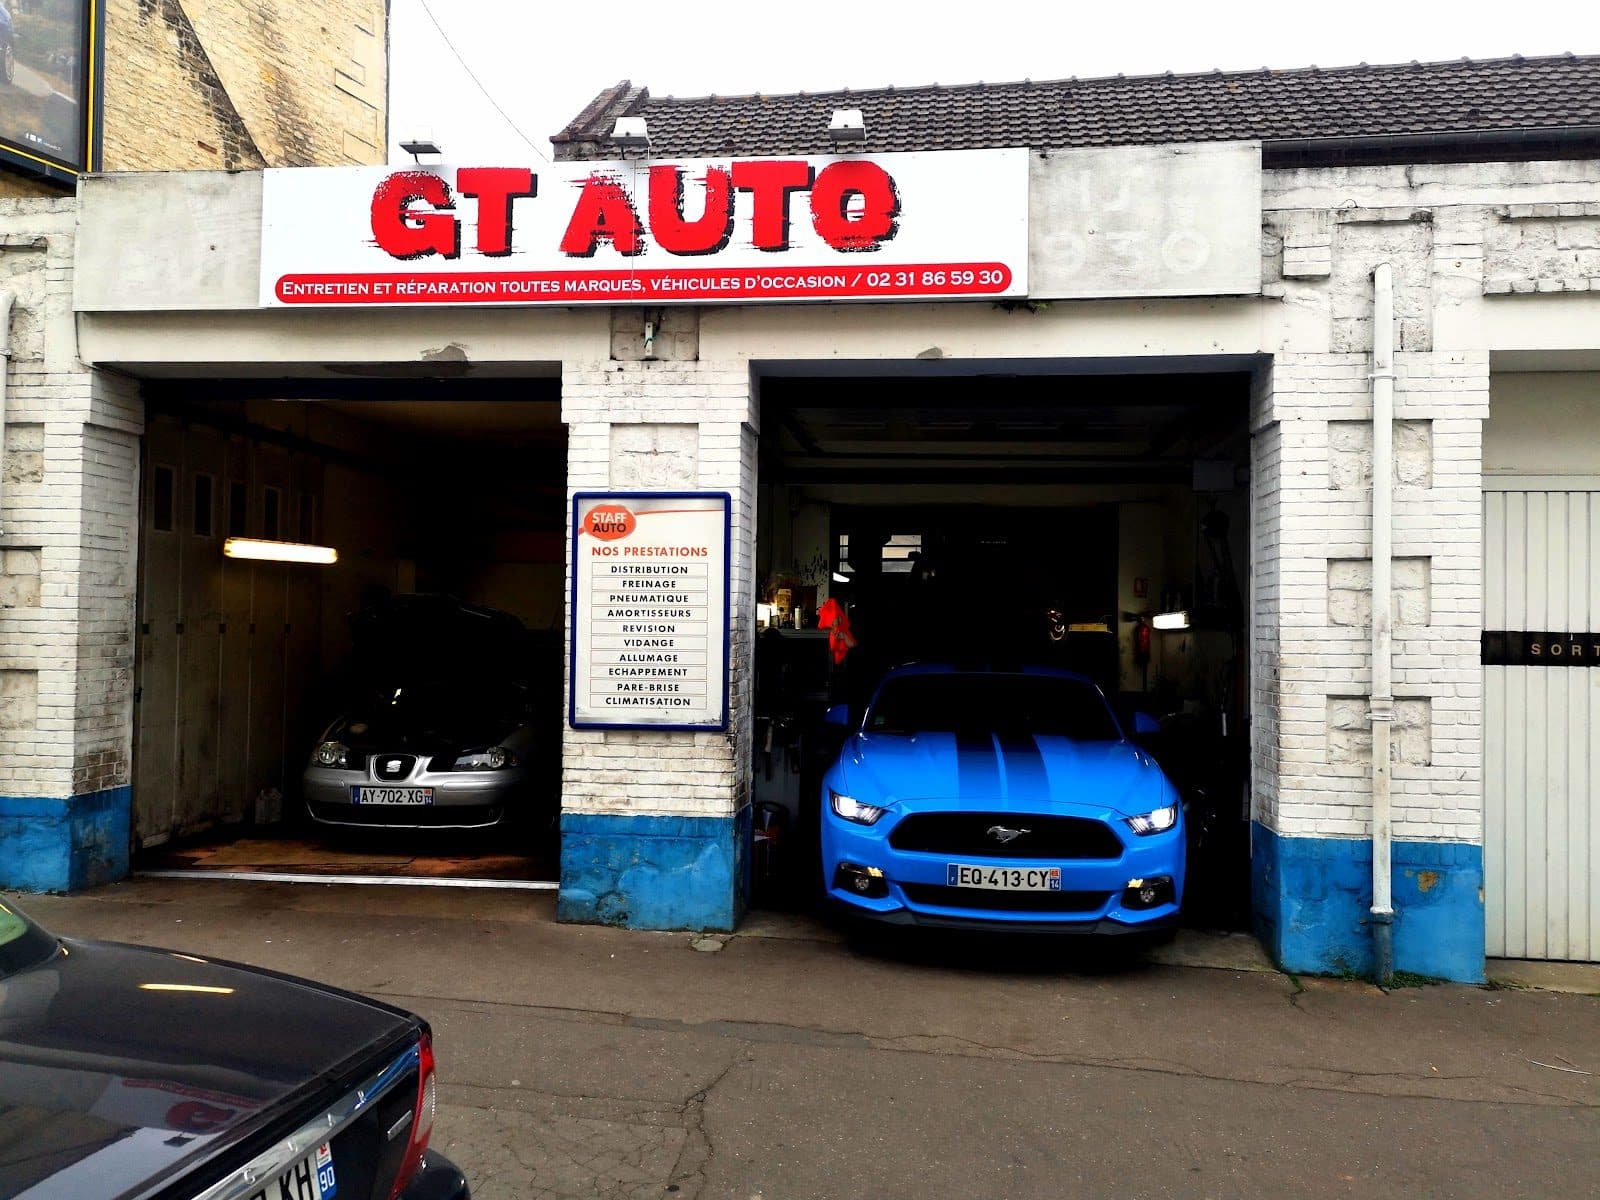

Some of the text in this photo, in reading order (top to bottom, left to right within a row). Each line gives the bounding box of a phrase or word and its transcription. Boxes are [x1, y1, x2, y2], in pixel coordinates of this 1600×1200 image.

[368, 160, 902, 260] GT AUTO
[282, 270, 1003, 295] ENTRETIEN ET RÉPARATION TOUTES MARQUES, VÉHICULES D'OCCASION / 02 31 86 59 30
[592, 513, 627, 523] STAFF
[592, 523, 627, 533] AUTO
[592, 547, 708, 557] NOS PRESTATIONS
[611, 566, 688, 574] DISTRIBUTION
[622, 580, 676, 588] FREINAGE
[610, 594, 689, 603] PNEUMATIQUE
[607, 609, 692, 618] AMORTISSEURS
[622, 624, 675, 633] REVISION
[624, 639, 674, 647] VIDANGE
[619, 654, 678, 662] ALLUMAGE
[608, 668, 688, 676] ECHAPPEMENT
[617, 683, 679, 692] PARE-BRISE
[605, 697, 691, 706] CLIMATISATION
[361, 789, 423, 804] AY-702-XG
[960, 867, 1048, 888] EQ-413-CY
[1050, 879, 1059, 888] 14
[320, 1166, 335, 1192] 90
